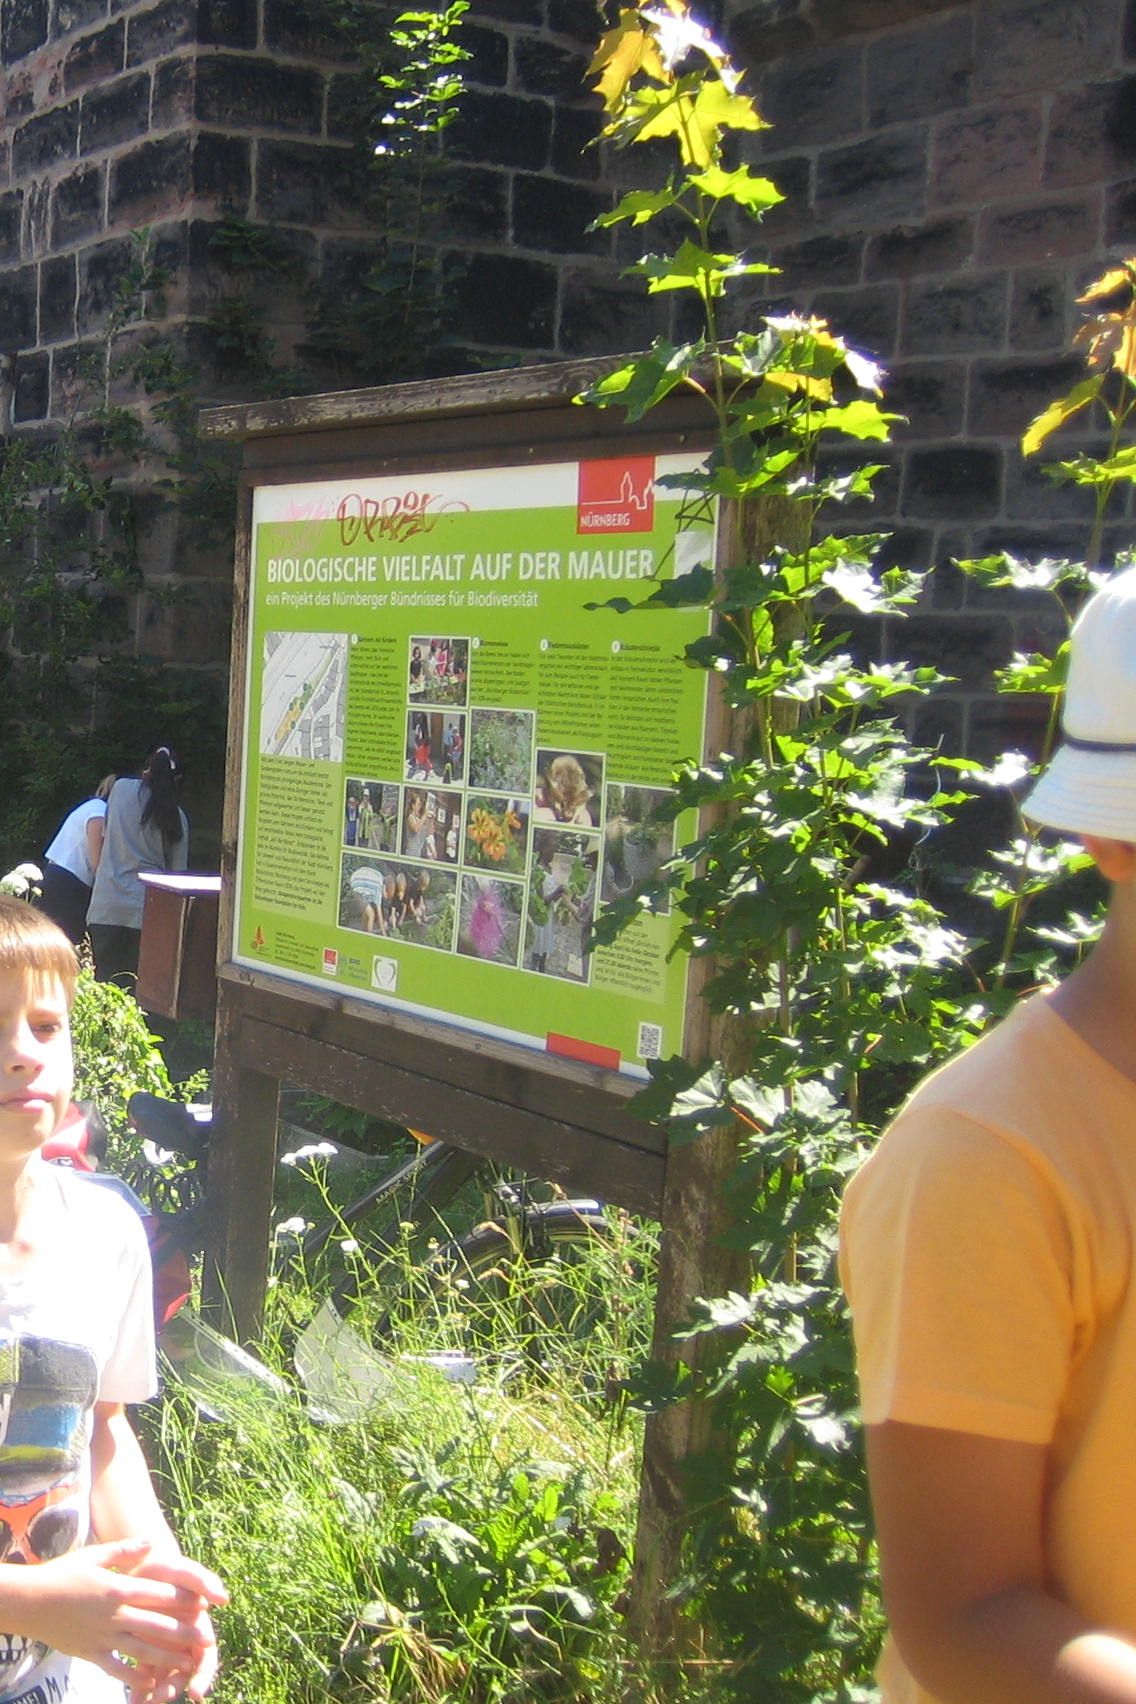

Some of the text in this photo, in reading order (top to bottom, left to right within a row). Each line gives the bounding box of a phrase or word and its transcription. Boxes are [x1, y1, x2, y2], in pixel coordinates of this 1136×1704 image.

[580, 511, 630, 528] NÜRNBERG
[266, 548, 654, 584] BIOLOGISCHE VIELFALT AUF DER MAUER
[265, 590, 539, 610] ein Projekt des Nürnberger Bündnisses für Biodiversität
